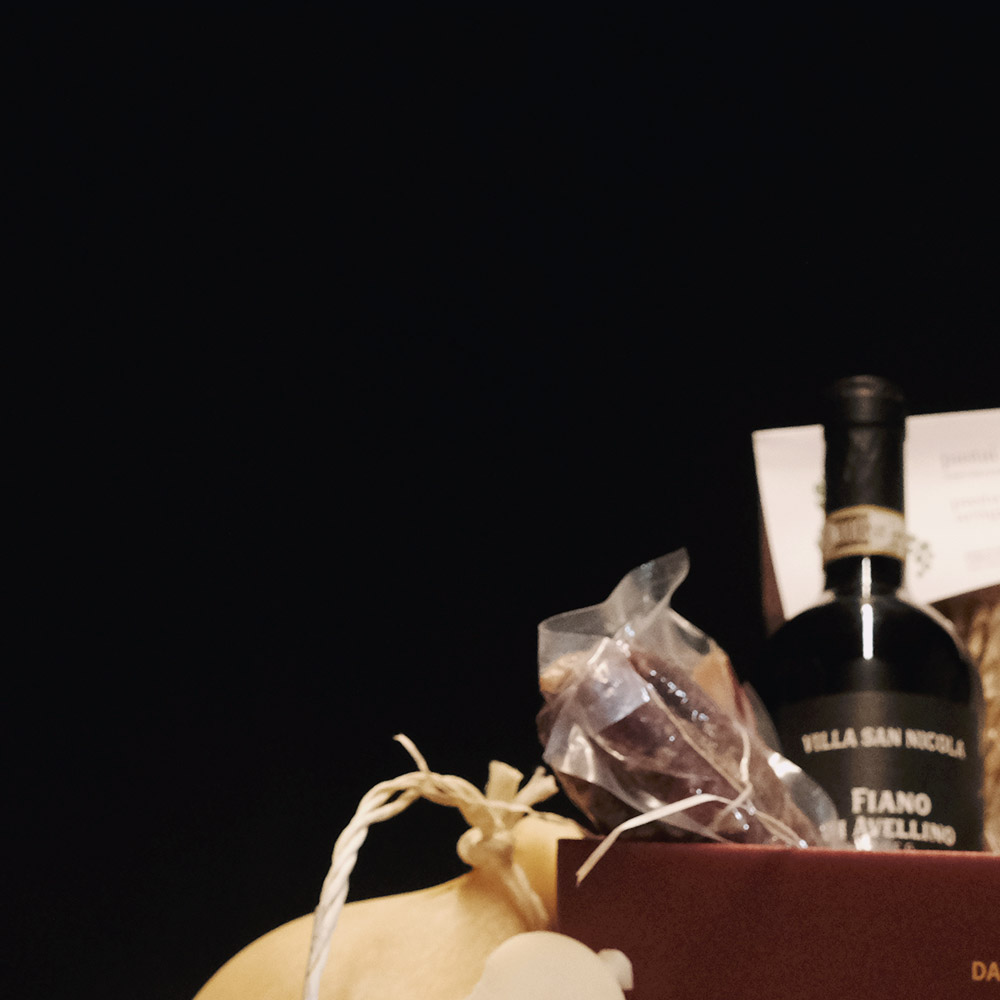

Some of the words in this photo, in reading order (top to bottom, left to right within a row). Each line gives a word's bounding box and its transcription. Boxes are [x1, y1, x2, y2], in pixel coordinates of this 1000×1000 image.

[801, 726, 858, 754] VILLA
[860, 726, 903, 748] SAN
[904, 728, 967, 761] NICOLA
[851, 786, 932, 817] FIANO
